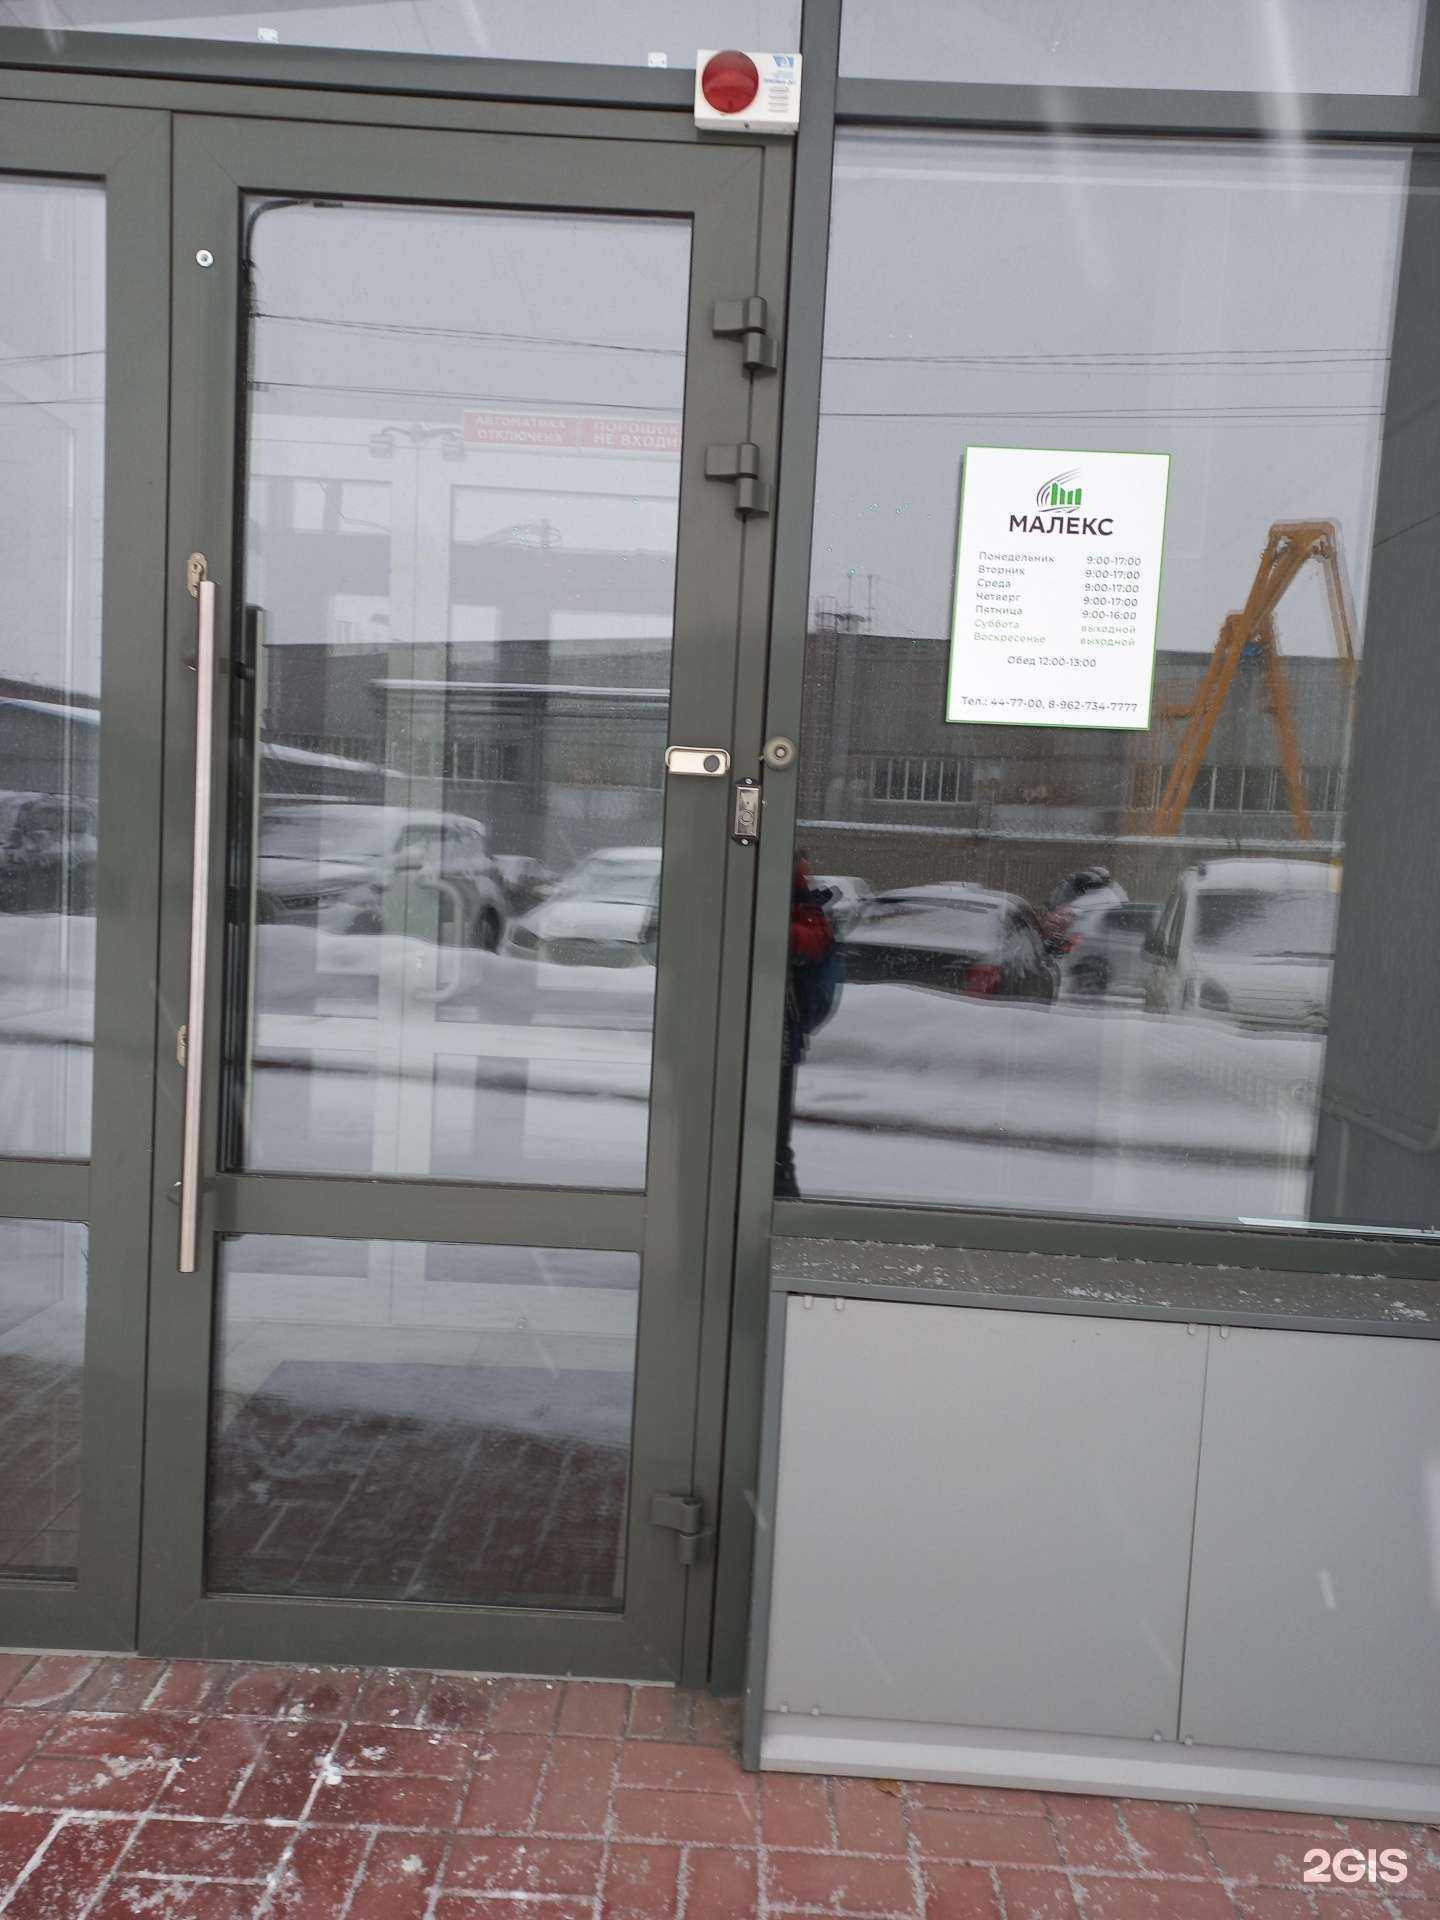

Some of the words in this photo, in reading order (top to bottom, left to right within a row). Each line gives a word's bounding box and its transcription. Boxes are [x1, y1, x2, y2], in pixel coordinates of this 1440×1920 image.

[475, 415, 567, 430] АВТОМАТИКА
[477, 429, 564, 444] ОТКЛЮЧЕНА
[592, 433, 616, 447] НЕ
[1009, 514, 1114, 536] МАЛЕКС
[979, 551, 1055, 564] Понедельник
[1086, 556, 1142, 567] 9:00-17:00
[978, 565, 1025, 577] Вторник
[1085, 569, 1141, 581] 9:00-17:00
[977, 578, 1011, 590] Среда
[1084, 583, 1140, 594] 9:00-17:00
[976, 592, 1022, 604] Четверг
[1083, 596, 1138, 607] 9:00-17:00
[975, 605, 1023, 617] Пятница
[1082, 609, 1137, 620] 9:00-16:00
[974, 619, 1020, 631] Суббота
[1081, 624, 1136, 635] выходной
[974, 632, 1047, 645] Воскресенье
[1080, 636, 1136, 648] выходной
[1007, 656, 1036, 668] Обед
[1038, 657, 1097, 668] 12:00-13:00
[961, 696, 988, 707] Тел.:
[990, 697, 1045, 710] 44-77-00,
[1048, 699, 1138, 713] 8-962-734-7777
